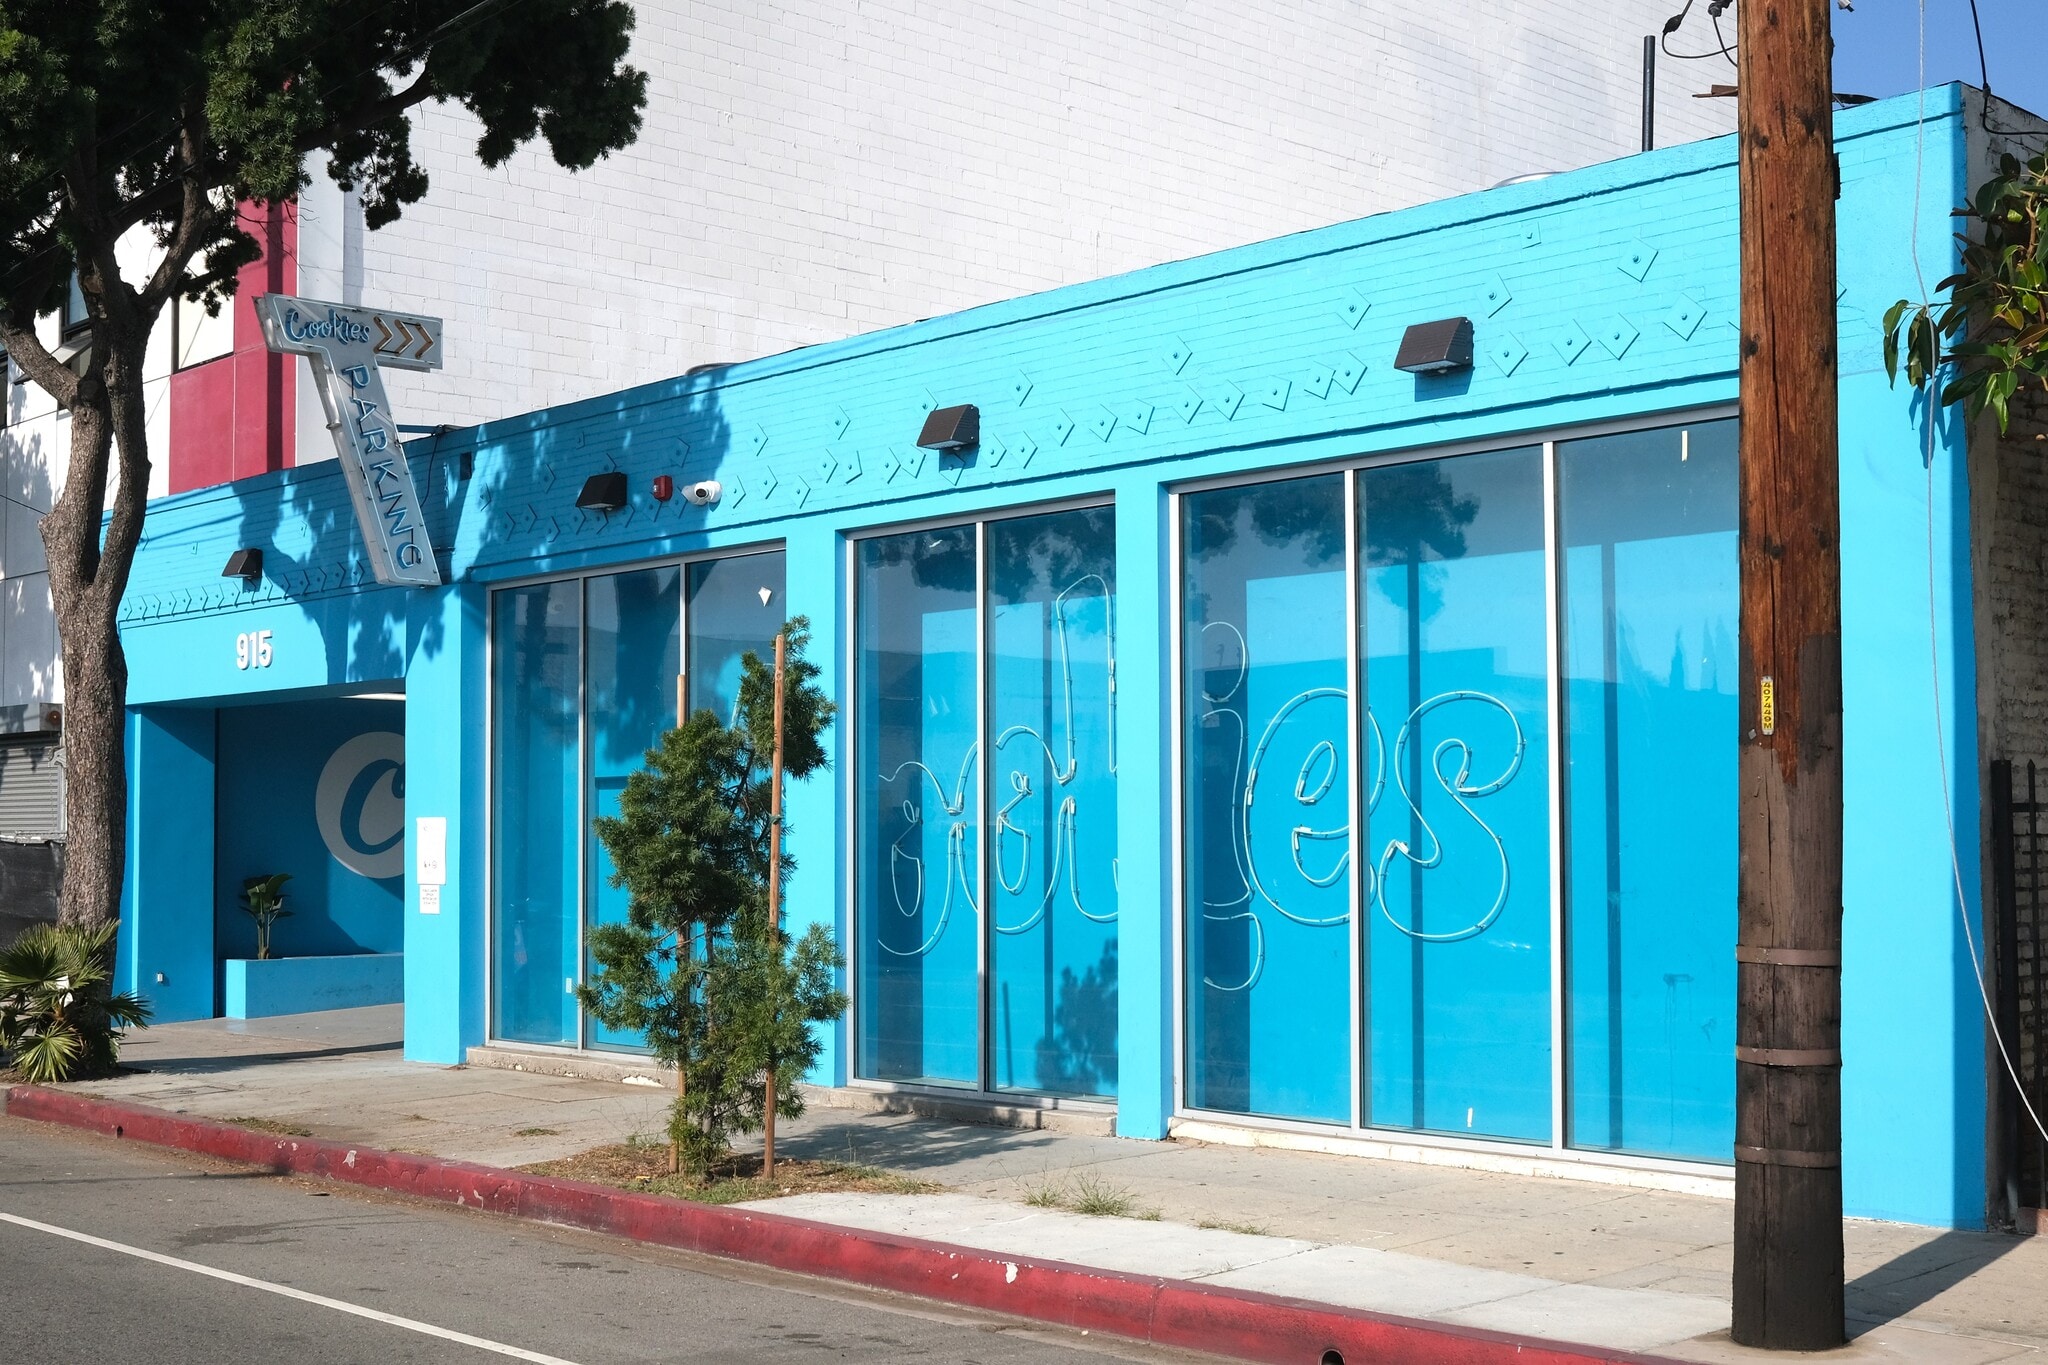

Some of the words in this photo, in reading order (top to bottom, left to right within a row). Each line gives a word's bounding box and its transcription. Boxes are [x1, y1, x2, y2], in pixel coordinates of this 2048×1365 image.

[285, 308, 371, 345] Cookies
[342, 364, 424, 569] PARKING
[235, 629, 273, 670] 915
[1763, 682, 1772, 729] 407449M
